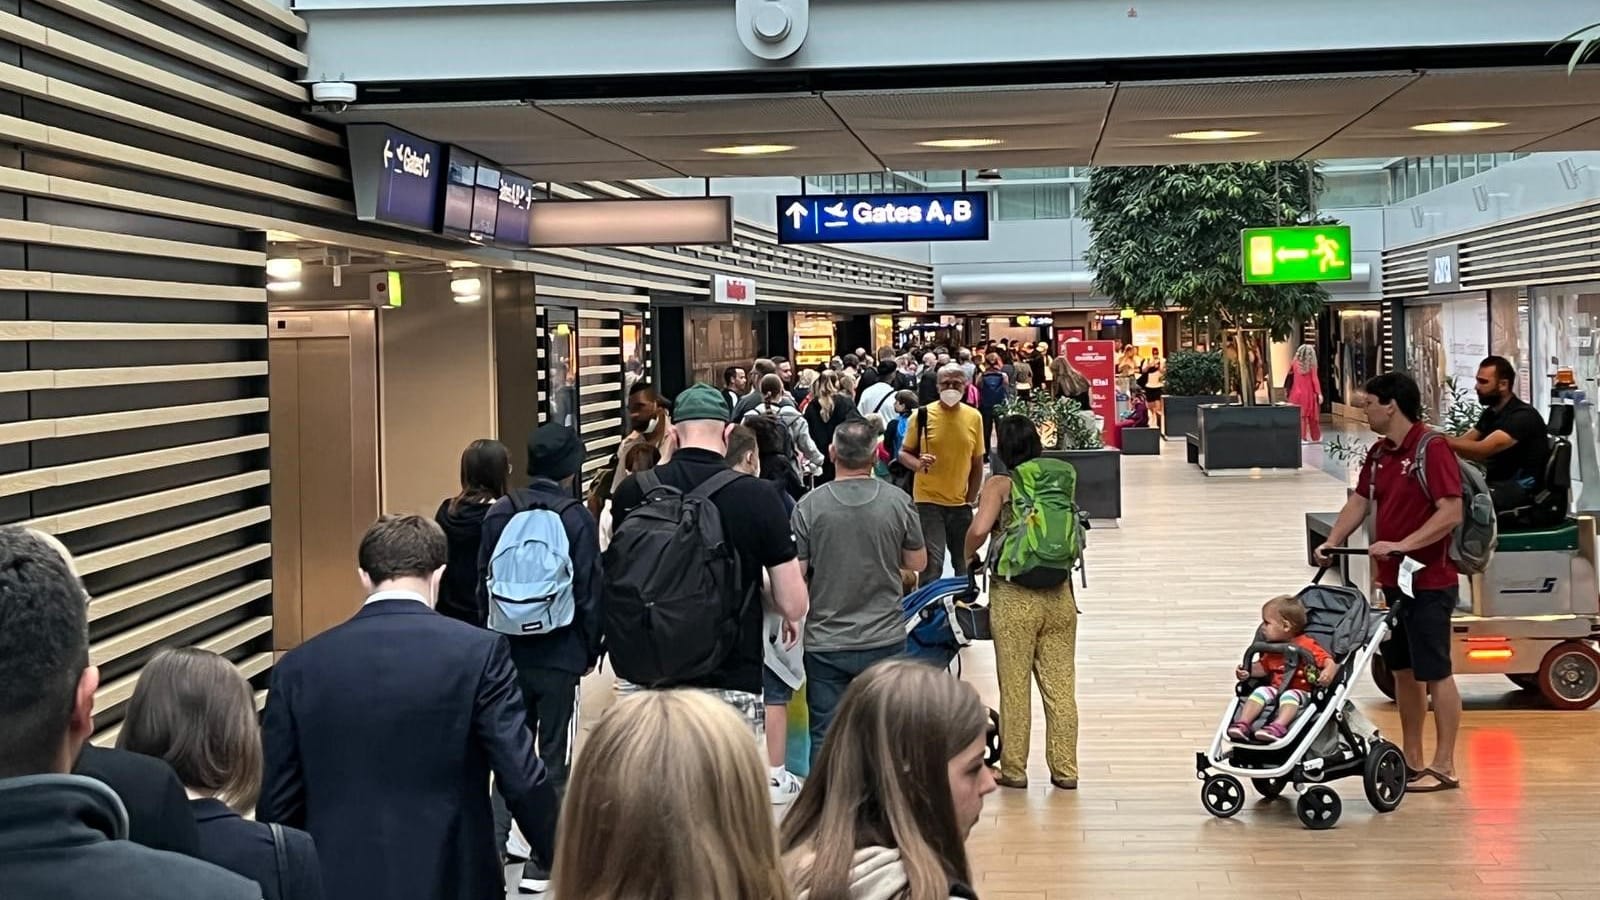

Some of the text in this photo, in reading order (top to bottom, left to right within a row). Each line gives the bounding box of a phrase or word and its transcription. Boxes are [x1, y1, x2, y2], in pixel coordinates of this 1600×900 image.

[403, 146, 431, 178] Gates C
[852, 202, 922, 224] Gates
